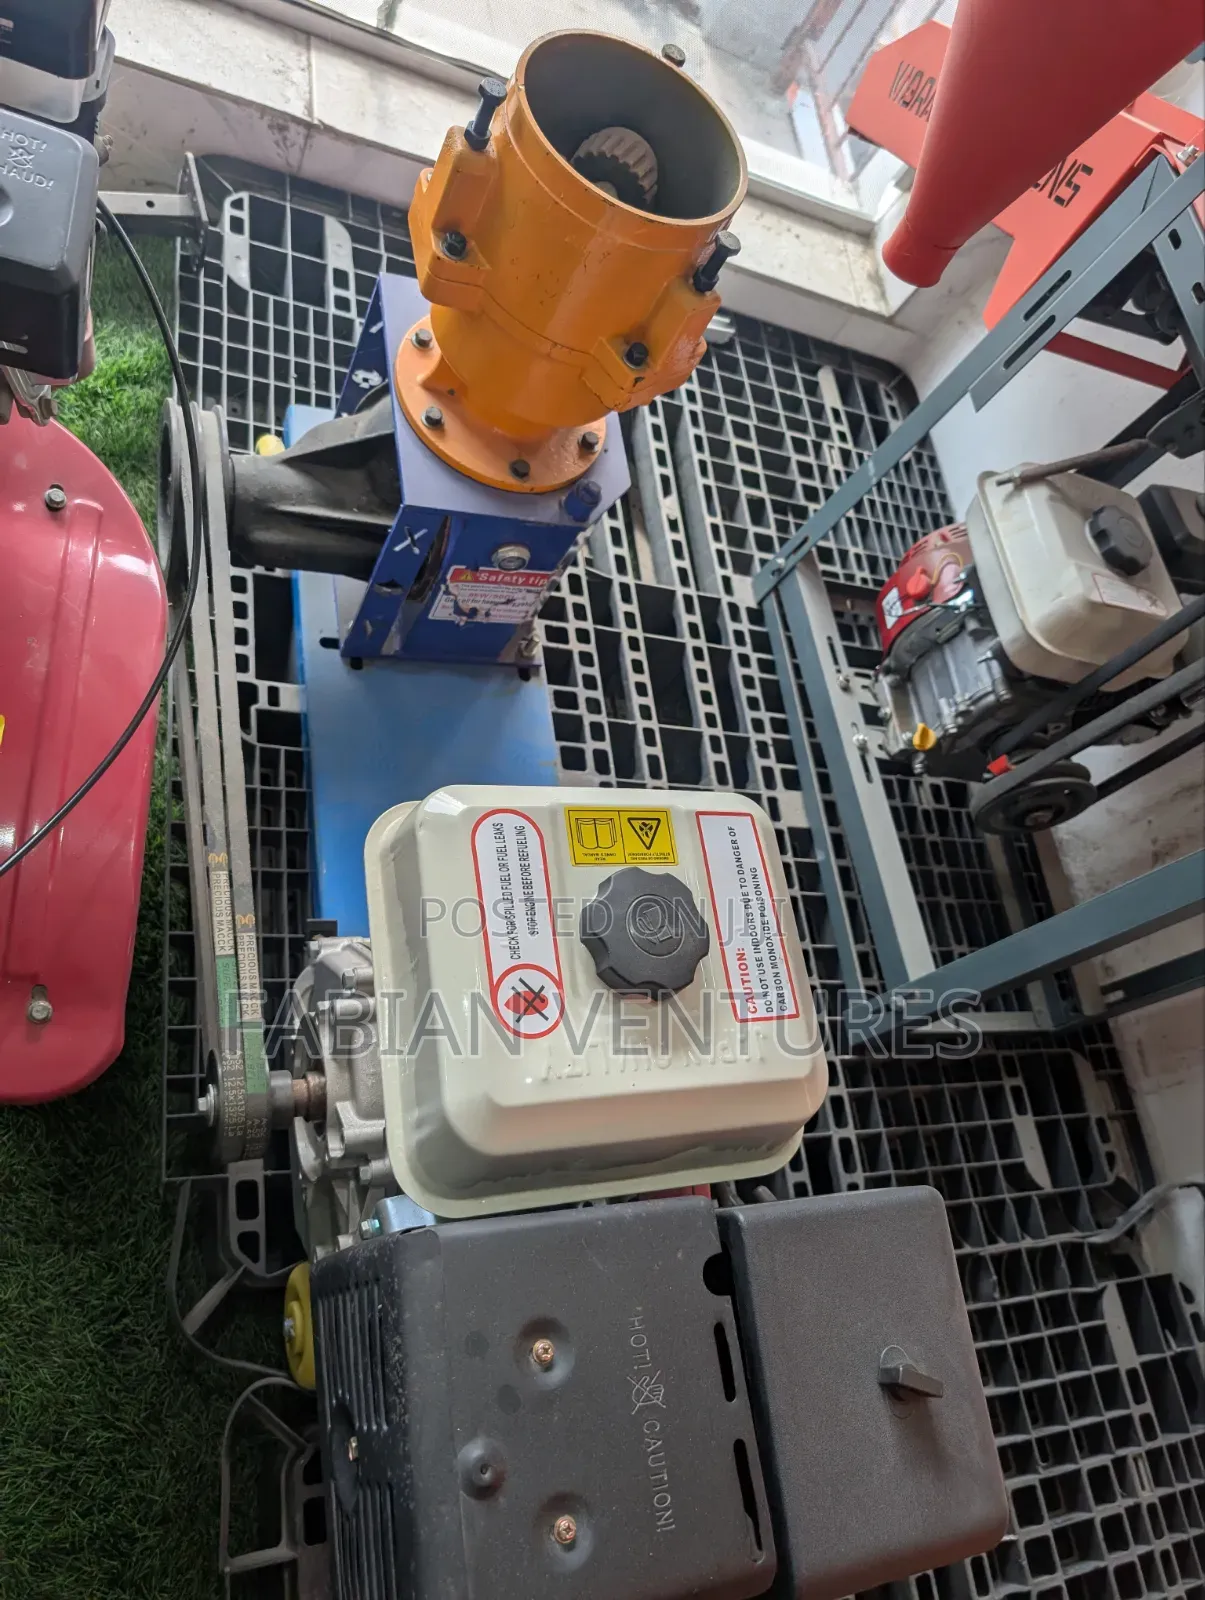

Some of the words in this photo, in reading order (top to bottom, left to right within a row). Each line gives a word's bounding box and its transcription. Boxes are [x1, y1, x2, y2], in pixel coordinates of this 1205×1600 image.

[1, 131, 47, 152] HOT!
[478, 572, 525, 586] Safety
[492, 822, 506, 844] LEAKS
[514, 825, 530, 862] REFUELING
[727, 826, 737, 837] OF
[495, 844, 509, 862] FUEL
[731, 839, 745, 875] DANGER
[498, 862, 510, 873] OR
[519, 862, 534, 890] BEFORE
[500, 873, 512, 890] FUEL
[739, 877, 748, 889] TO
[749, 867, 767, 918] POISONING
[213, 873, 224, 918] PRECIOUS
[501, 891, 516, 920] SPILLED
[523, 890, 537, 917] ENGINE
[741, 891, 752, 910] DUE
[216, 920, 227, 952] MACCK
[505, 920, 518, 935] FOR
[526, 917, 540, 936] STOP
[745, 912, 760, 954] INDOORS
[246, 935, 258, 981] PRECIOUS
[507, 935, 521, 960] CHECK
[761, 920, 779, 969] MONOXIDE
[755, 956, 766, 975] USE
[735, 948, 757, 1014] CAUTION:
[759, 978, 770, 997] NOT
[773, 971, 788, 1012] CARBON
[249, 981, 260, 1016] MACCK
[764, 1000, 774, 1013] DO
[628, 1315, 652, 1370] HOT!
[643, 1420, 676, 1532] CAUTION!
